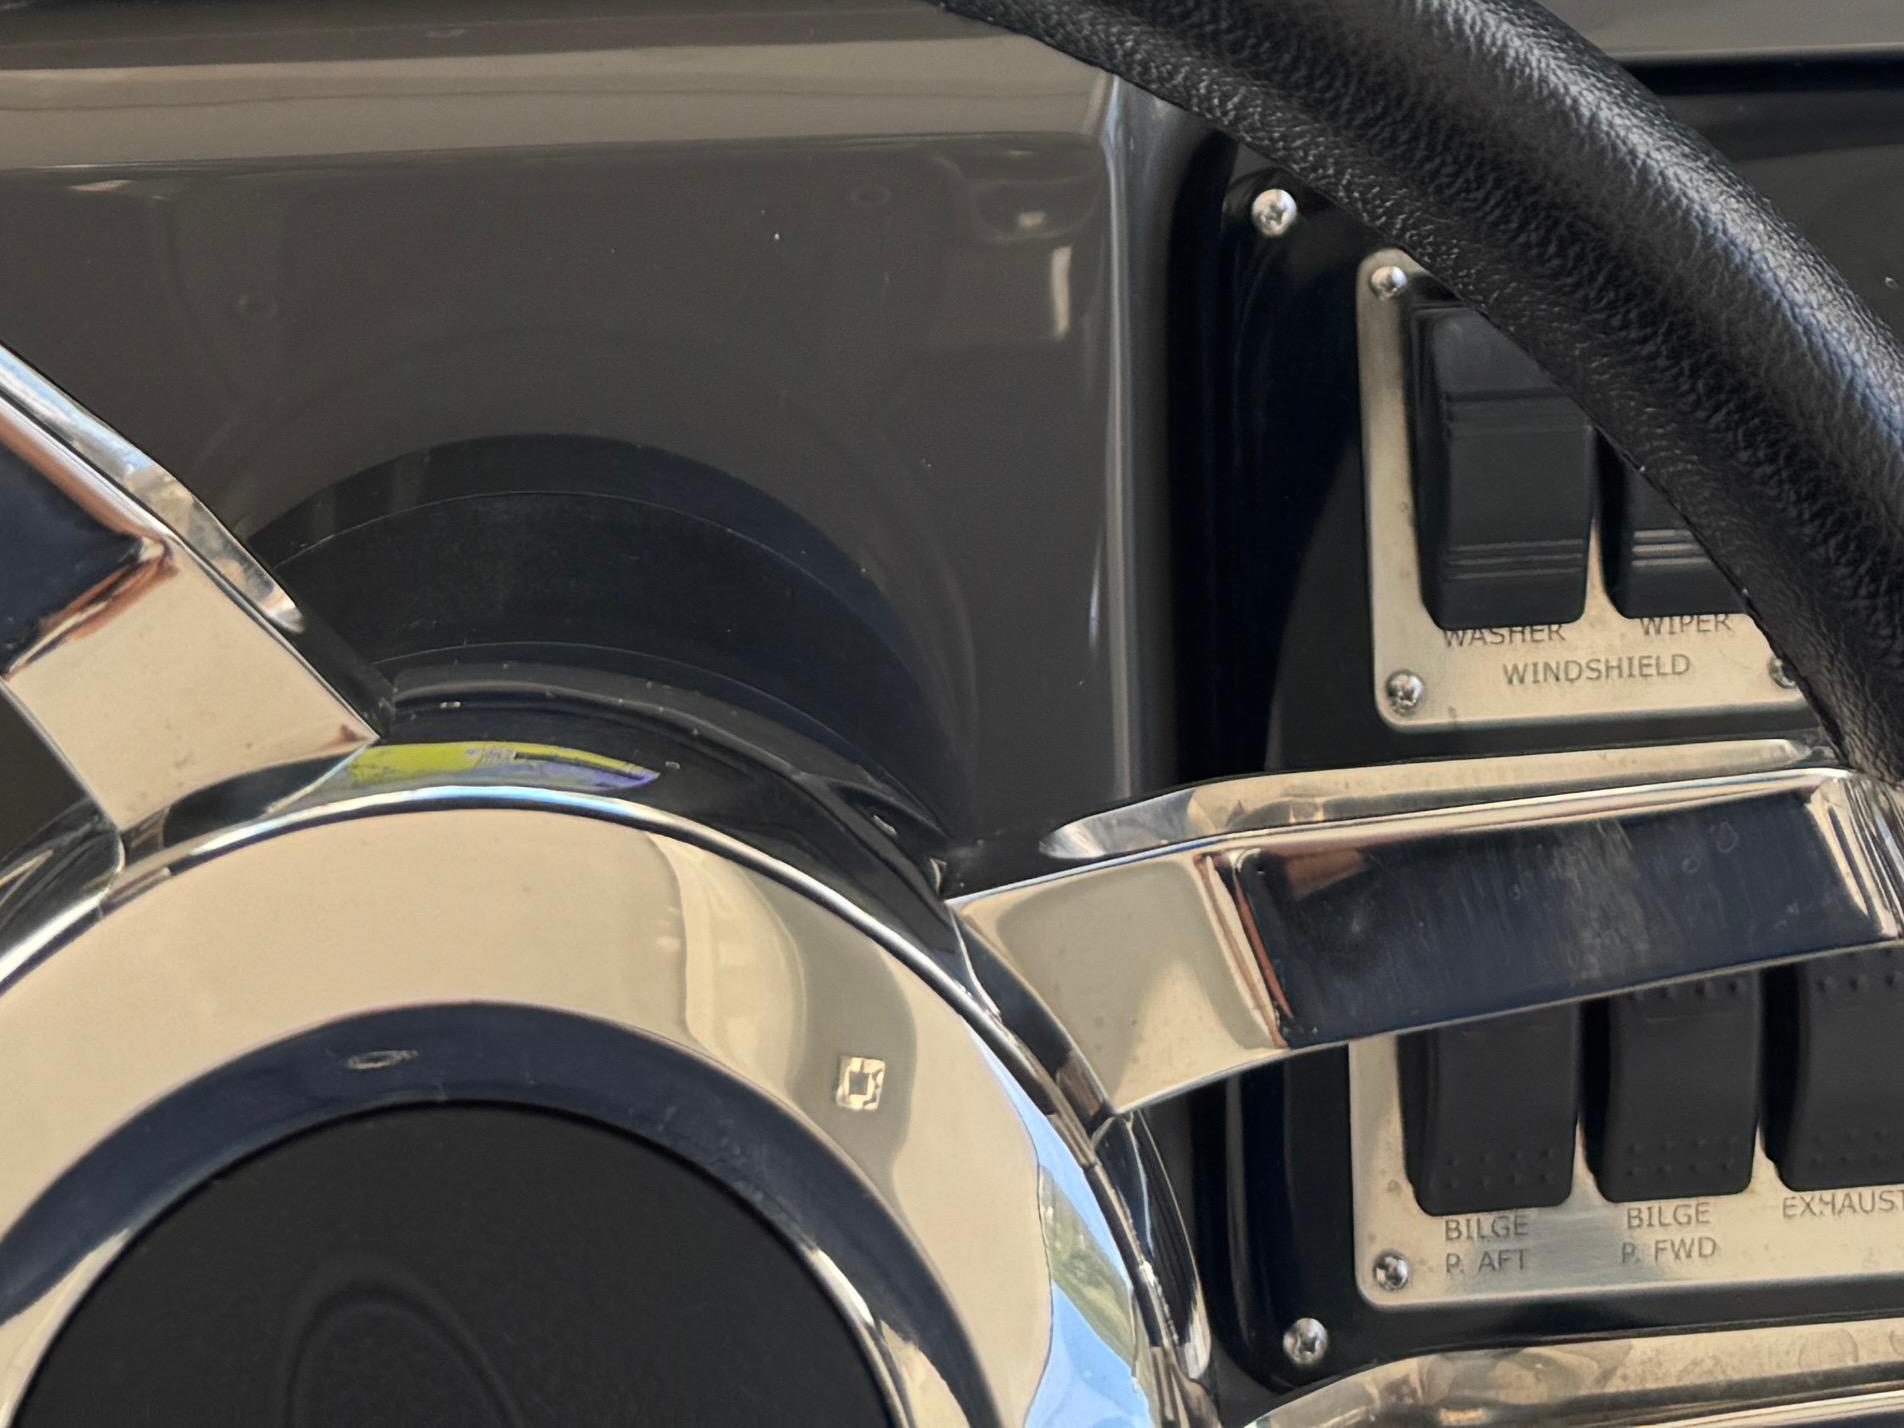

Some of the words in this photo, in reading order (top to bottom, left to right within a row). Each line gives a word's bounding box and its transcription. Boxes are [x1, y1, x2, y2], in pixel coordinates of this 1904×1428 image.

[1443, 624, 1566, 649] WASHER
[1639, 613, 1733, 637] WIPER
[1502, 653, 1691, 686] WINDSHIELD
[1444, 1214, 1530, 1242] BILGE
[1625, 1201, 1712, 1231] BILGE
[1477, 1247, 1529, 1274] AFT
[1653, 1237, 1719, 1264] FWD
